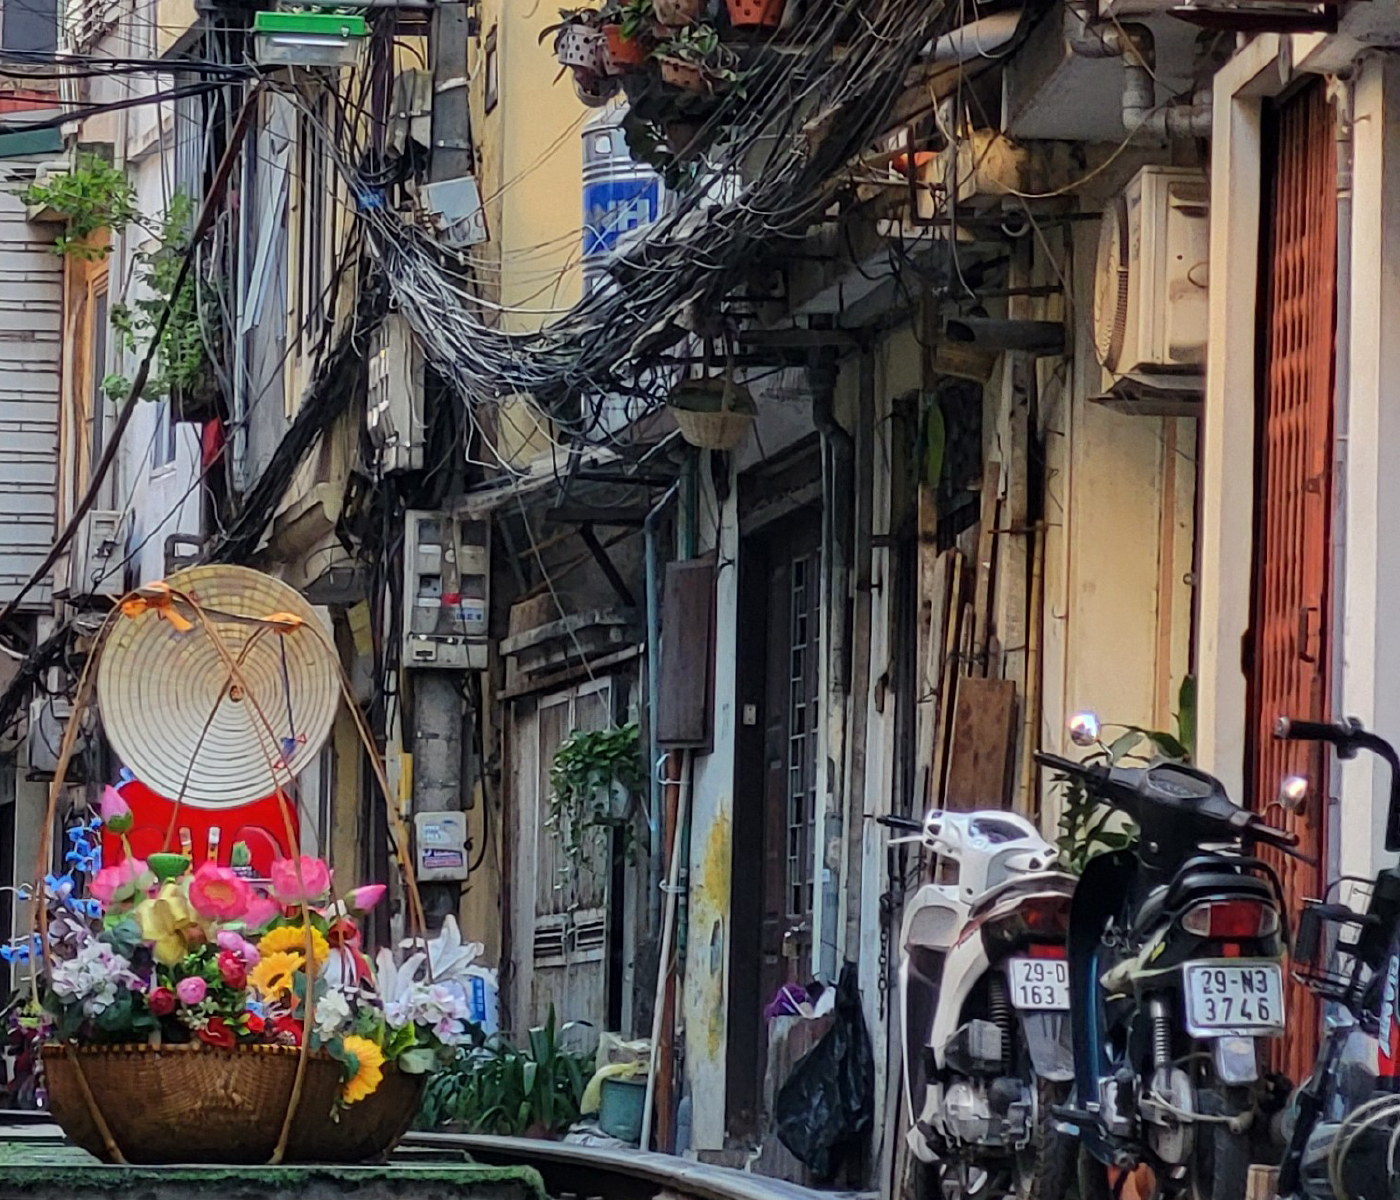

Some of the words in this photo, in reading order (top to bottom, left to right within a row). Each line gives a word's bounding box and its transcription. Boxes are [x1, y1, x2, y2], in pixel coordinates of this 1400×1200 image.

[1200, 970, 1268, 994] 29-N3
[1021, 986, 1070, 1005] 163.
[1205, 997, 1270, 1022] 3746
